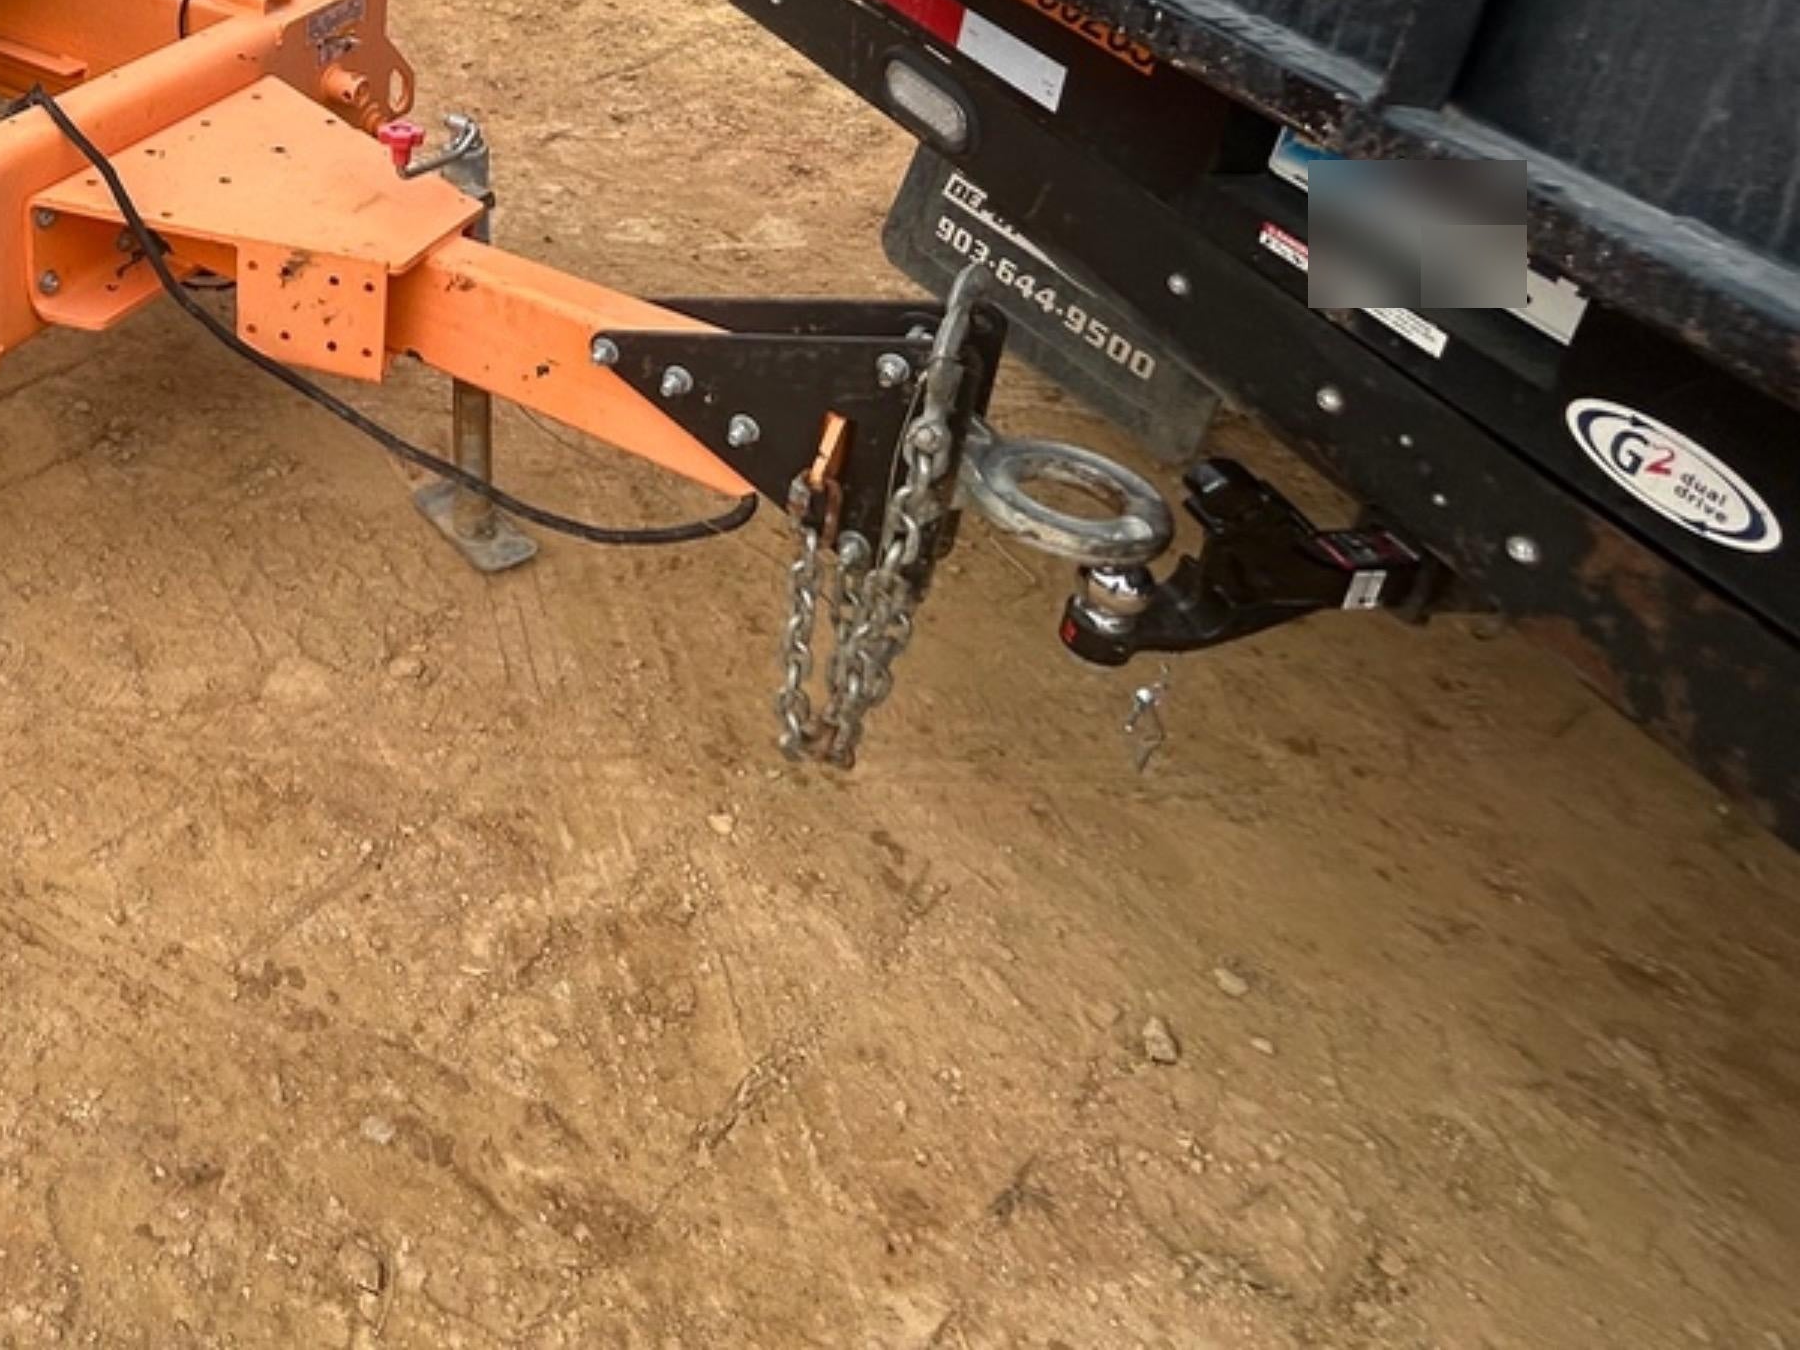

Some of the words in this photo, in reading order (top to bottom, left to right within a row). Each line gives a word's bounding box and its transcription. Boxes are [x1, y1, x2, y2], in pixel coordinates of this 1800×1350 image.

[935, 215, 1156, 380] 903.644.9500
[1610, 430, 1676, 477] G2
[1673, 484, 1728, 524] drive
[1679, 472, 1727, 508] dual
